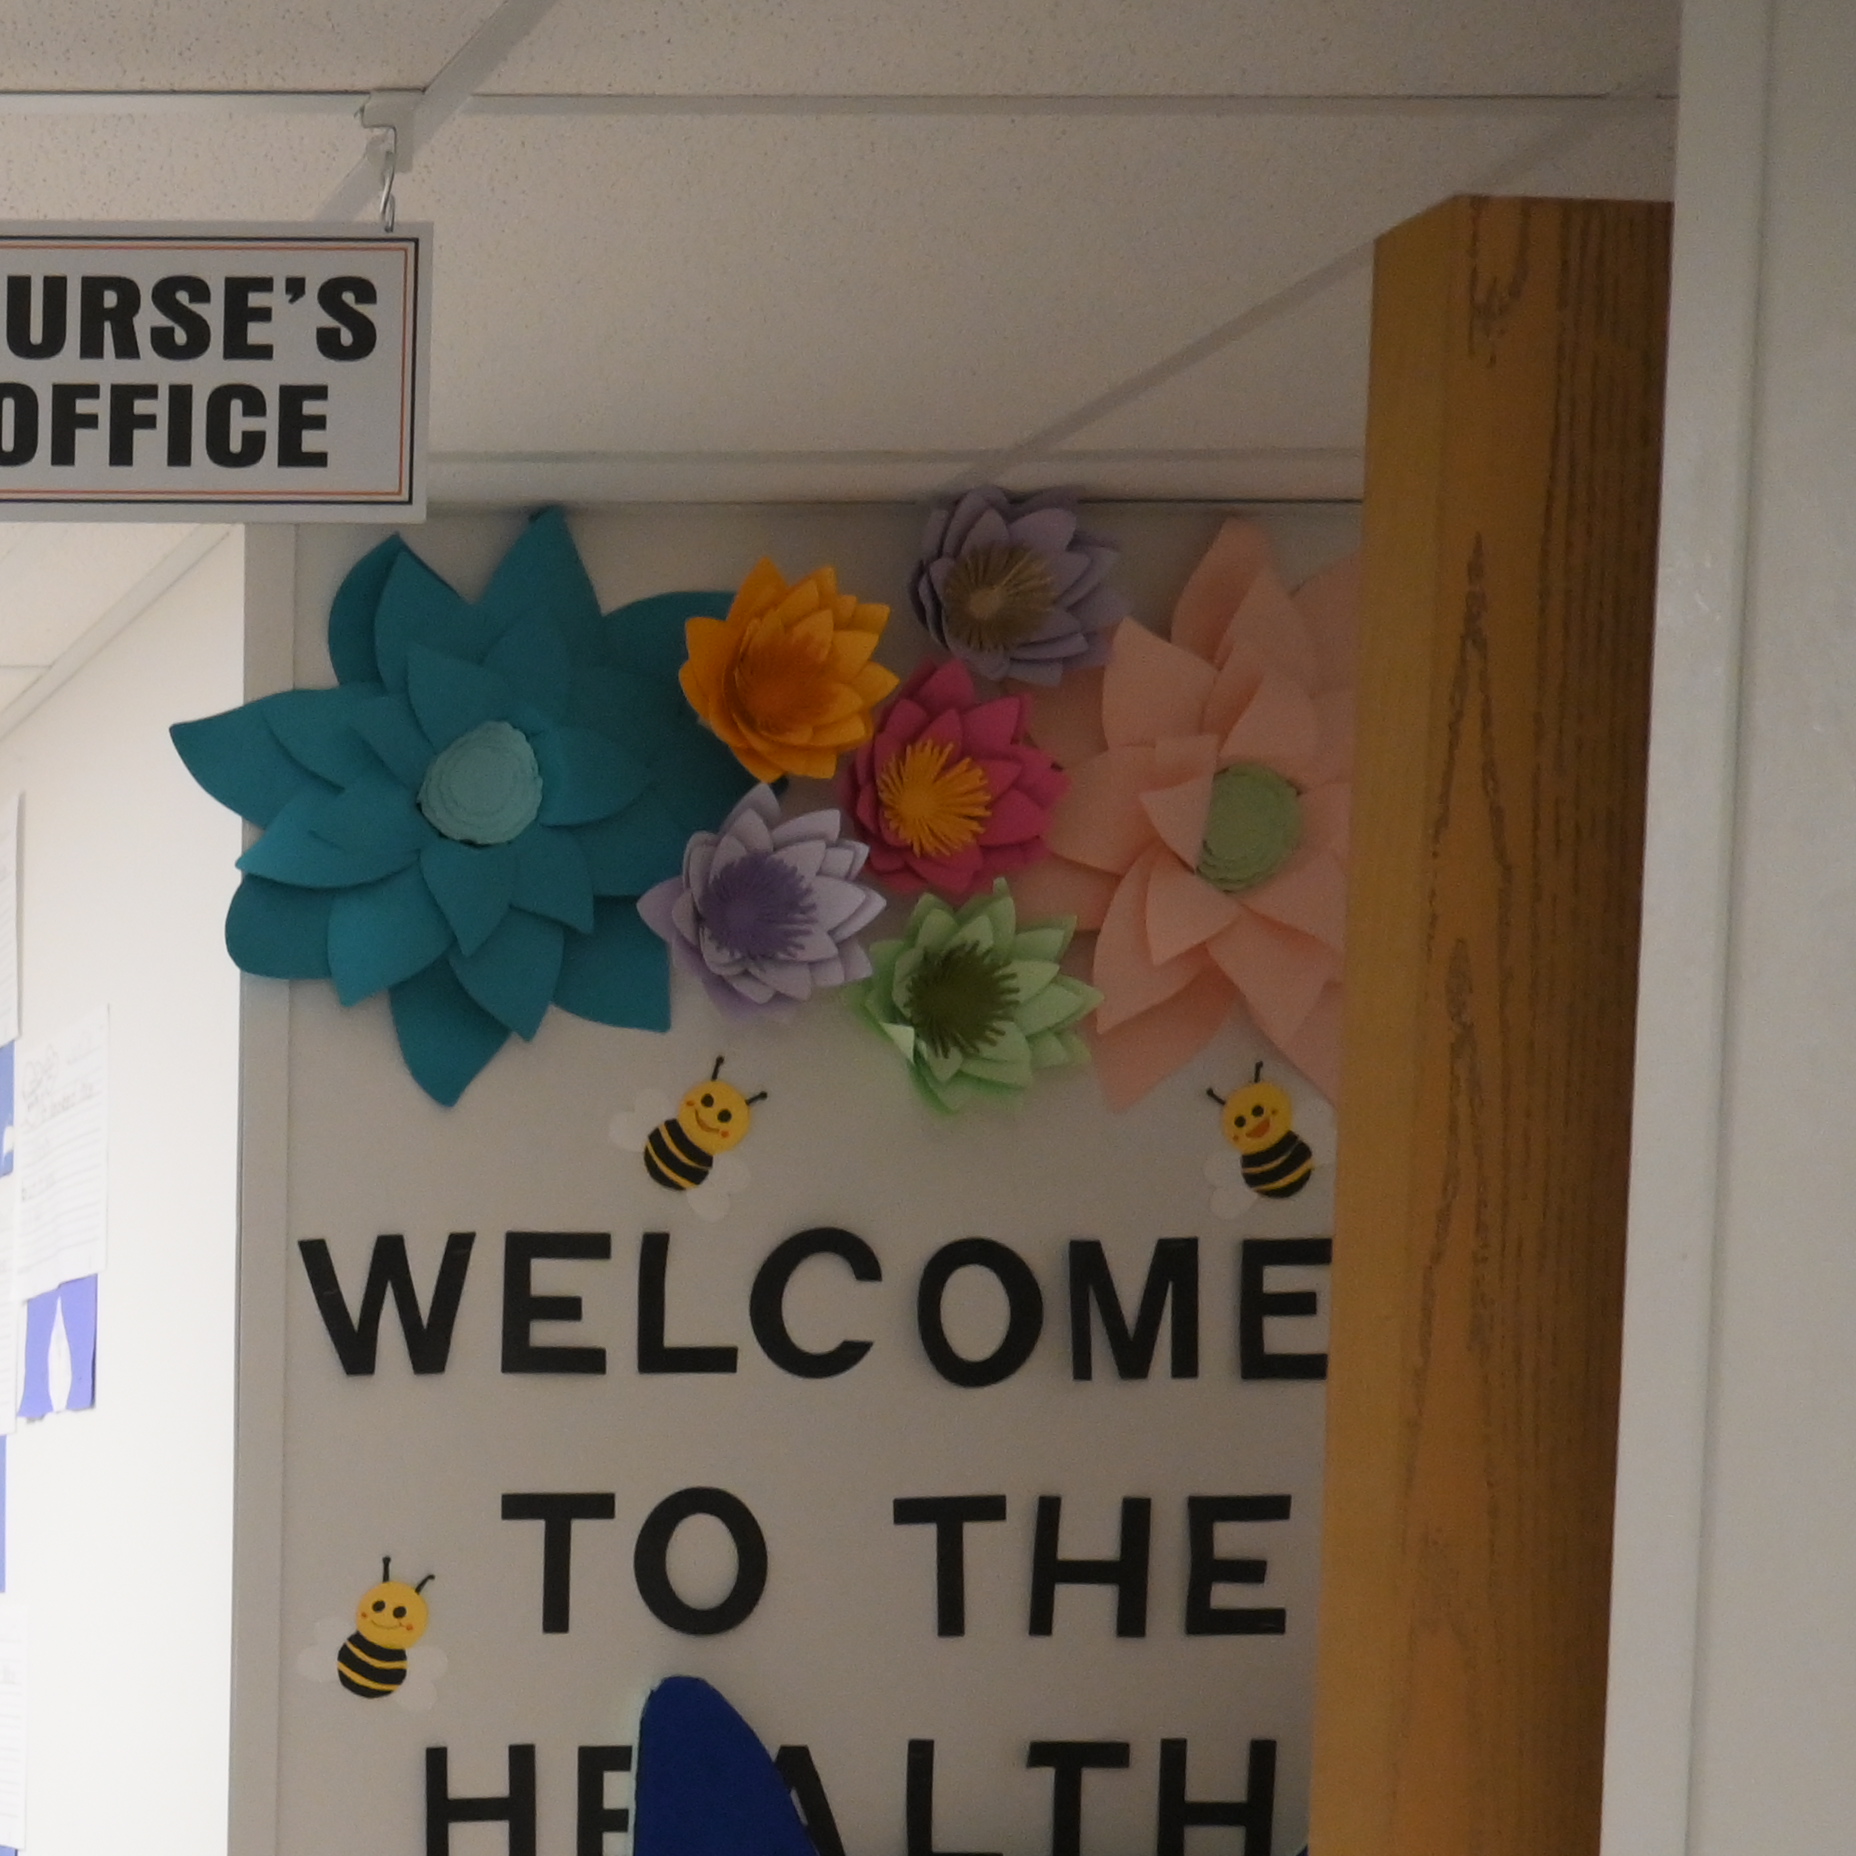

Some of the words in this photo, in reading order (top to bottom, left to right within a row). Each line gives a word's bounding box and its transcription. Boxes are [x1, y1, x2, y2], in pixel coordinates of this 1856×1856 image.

[297, 1226, 1333, 1388] WELCOME
[500, 1484, 770, 1638] TO
[891, 1492, 1292, 1639] THE
